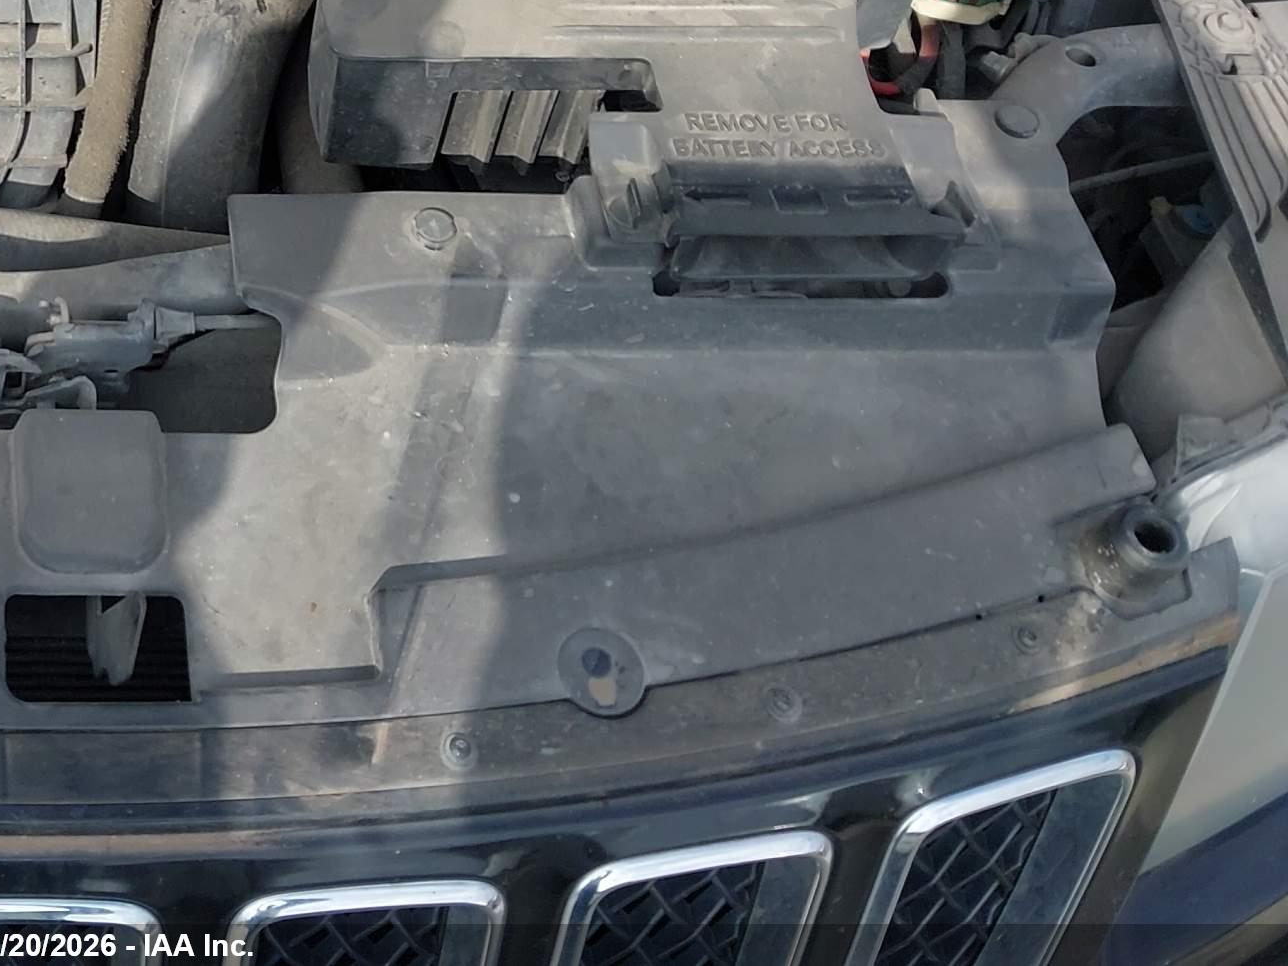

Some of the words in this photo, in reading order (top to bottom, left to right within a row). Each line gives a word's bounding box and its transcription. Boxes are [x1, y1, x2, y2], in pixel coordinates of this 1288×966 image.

[684, 113, 791, 132] REMOVE
[795, 114, 848, 132] FOR
[672, 138, 776, 157] BATTERY
[788, 139, 886, 158] ACCESS
